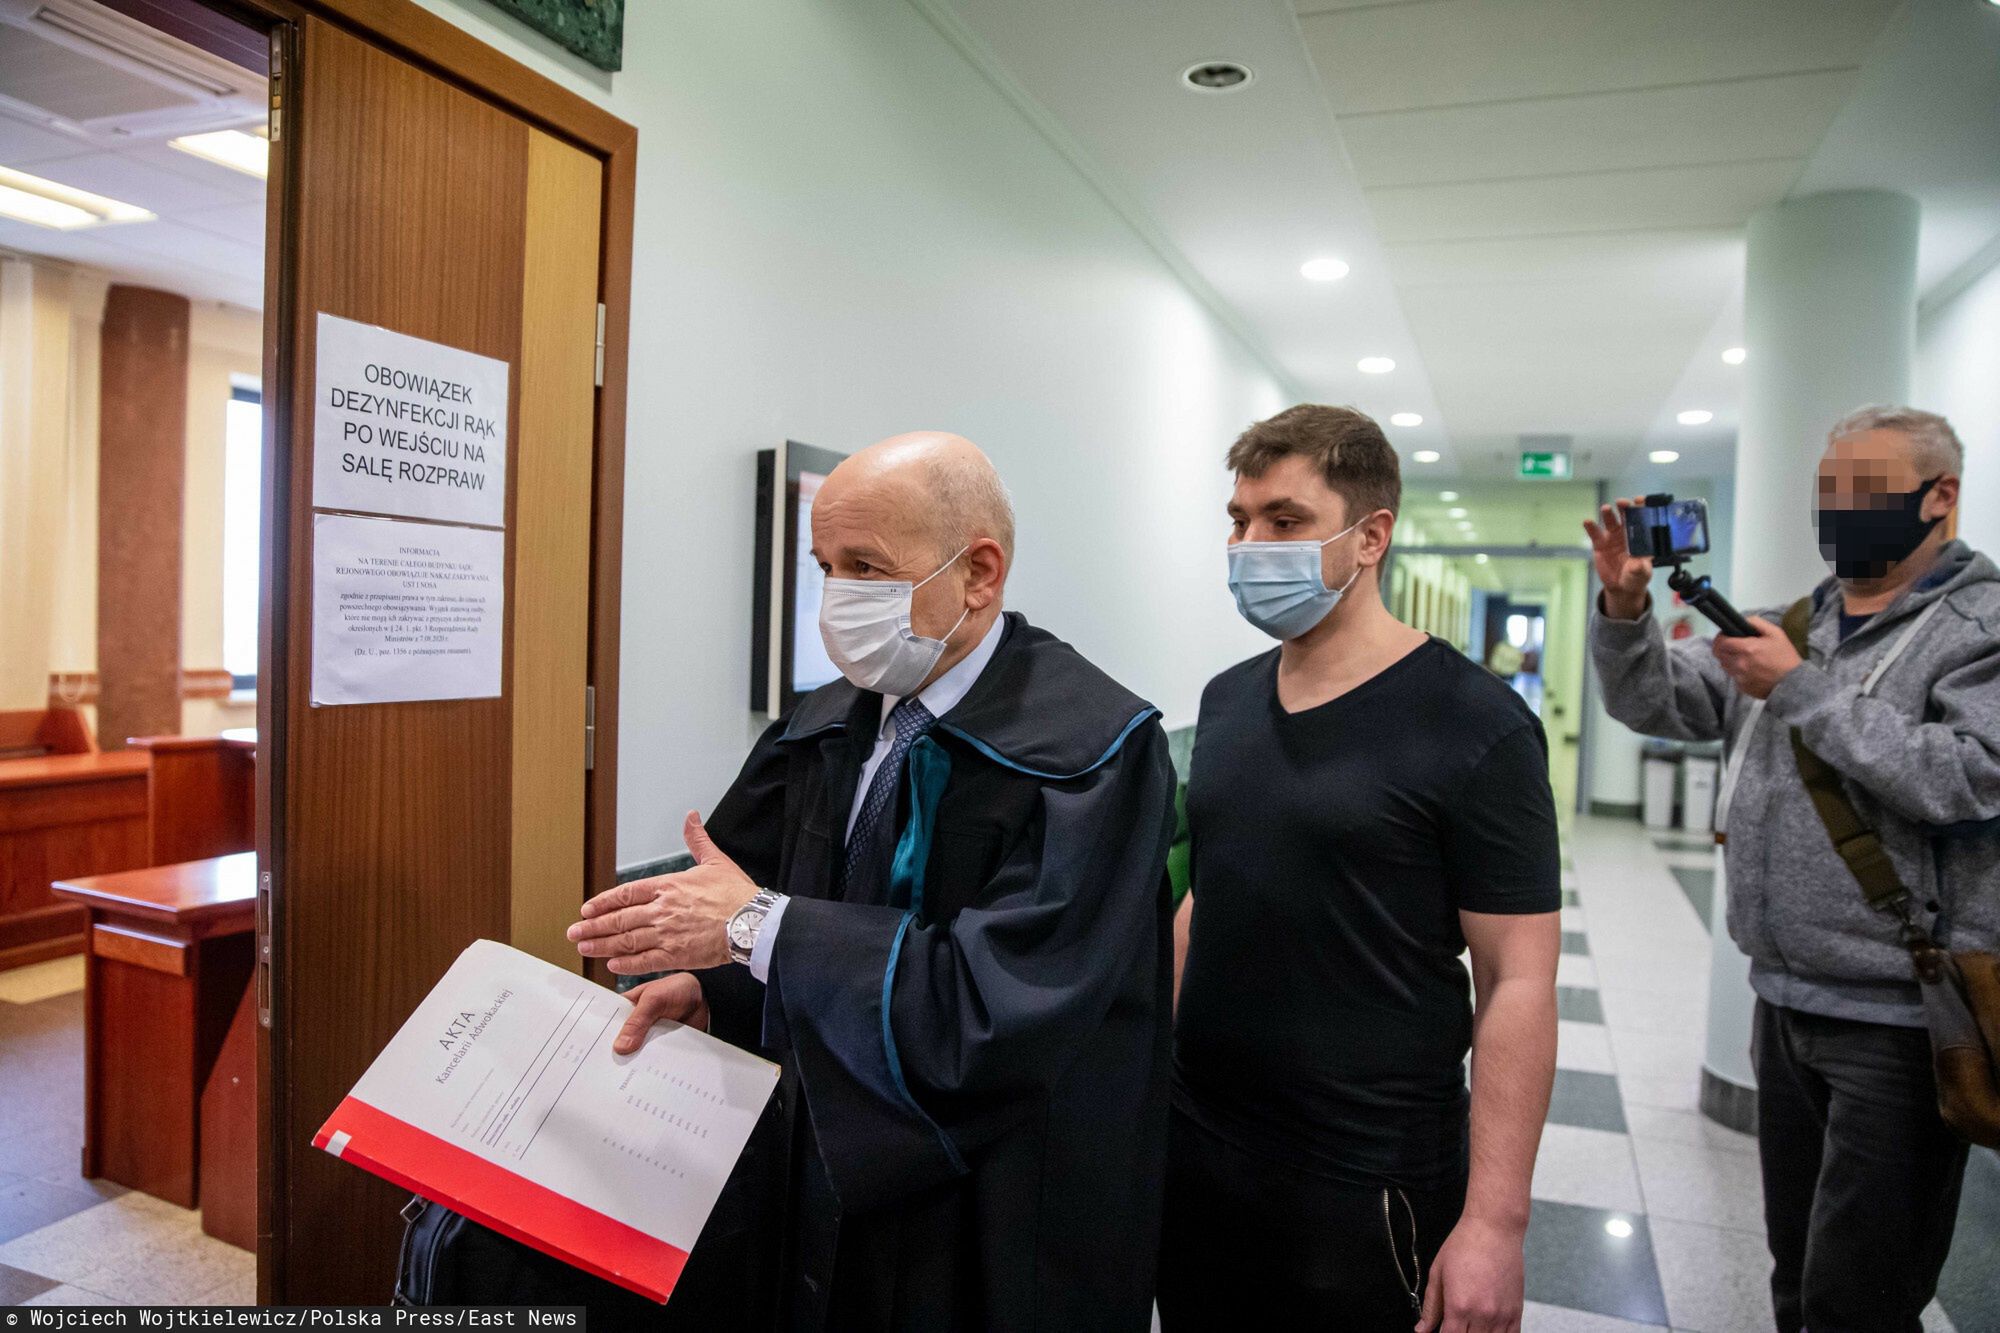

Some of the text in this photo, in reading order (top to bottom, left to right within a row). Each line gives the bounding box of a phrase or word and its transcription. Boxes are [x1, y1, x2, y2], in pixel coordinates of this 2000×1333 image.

[364, 364, 472, 404] OBOWIĄZEK
[331, 387, 496, 440] DEZYNFEKCJI RĄK
[344, 422, 485, 463] PO WEJŚCIU NA
[342, 453, 485, 490] SALĘ ROZPRAW
[336, 567, 386, 576] REJONOWEGO
[358, 557, 369, 566] NA
[371, 558, 398, 567] TERENIE
[435, 1040, 472, 1084] Kancelarii
[469, 988, 513, 1040] Adwokackiej
[439, 1011, 475, 1051] AKTA
